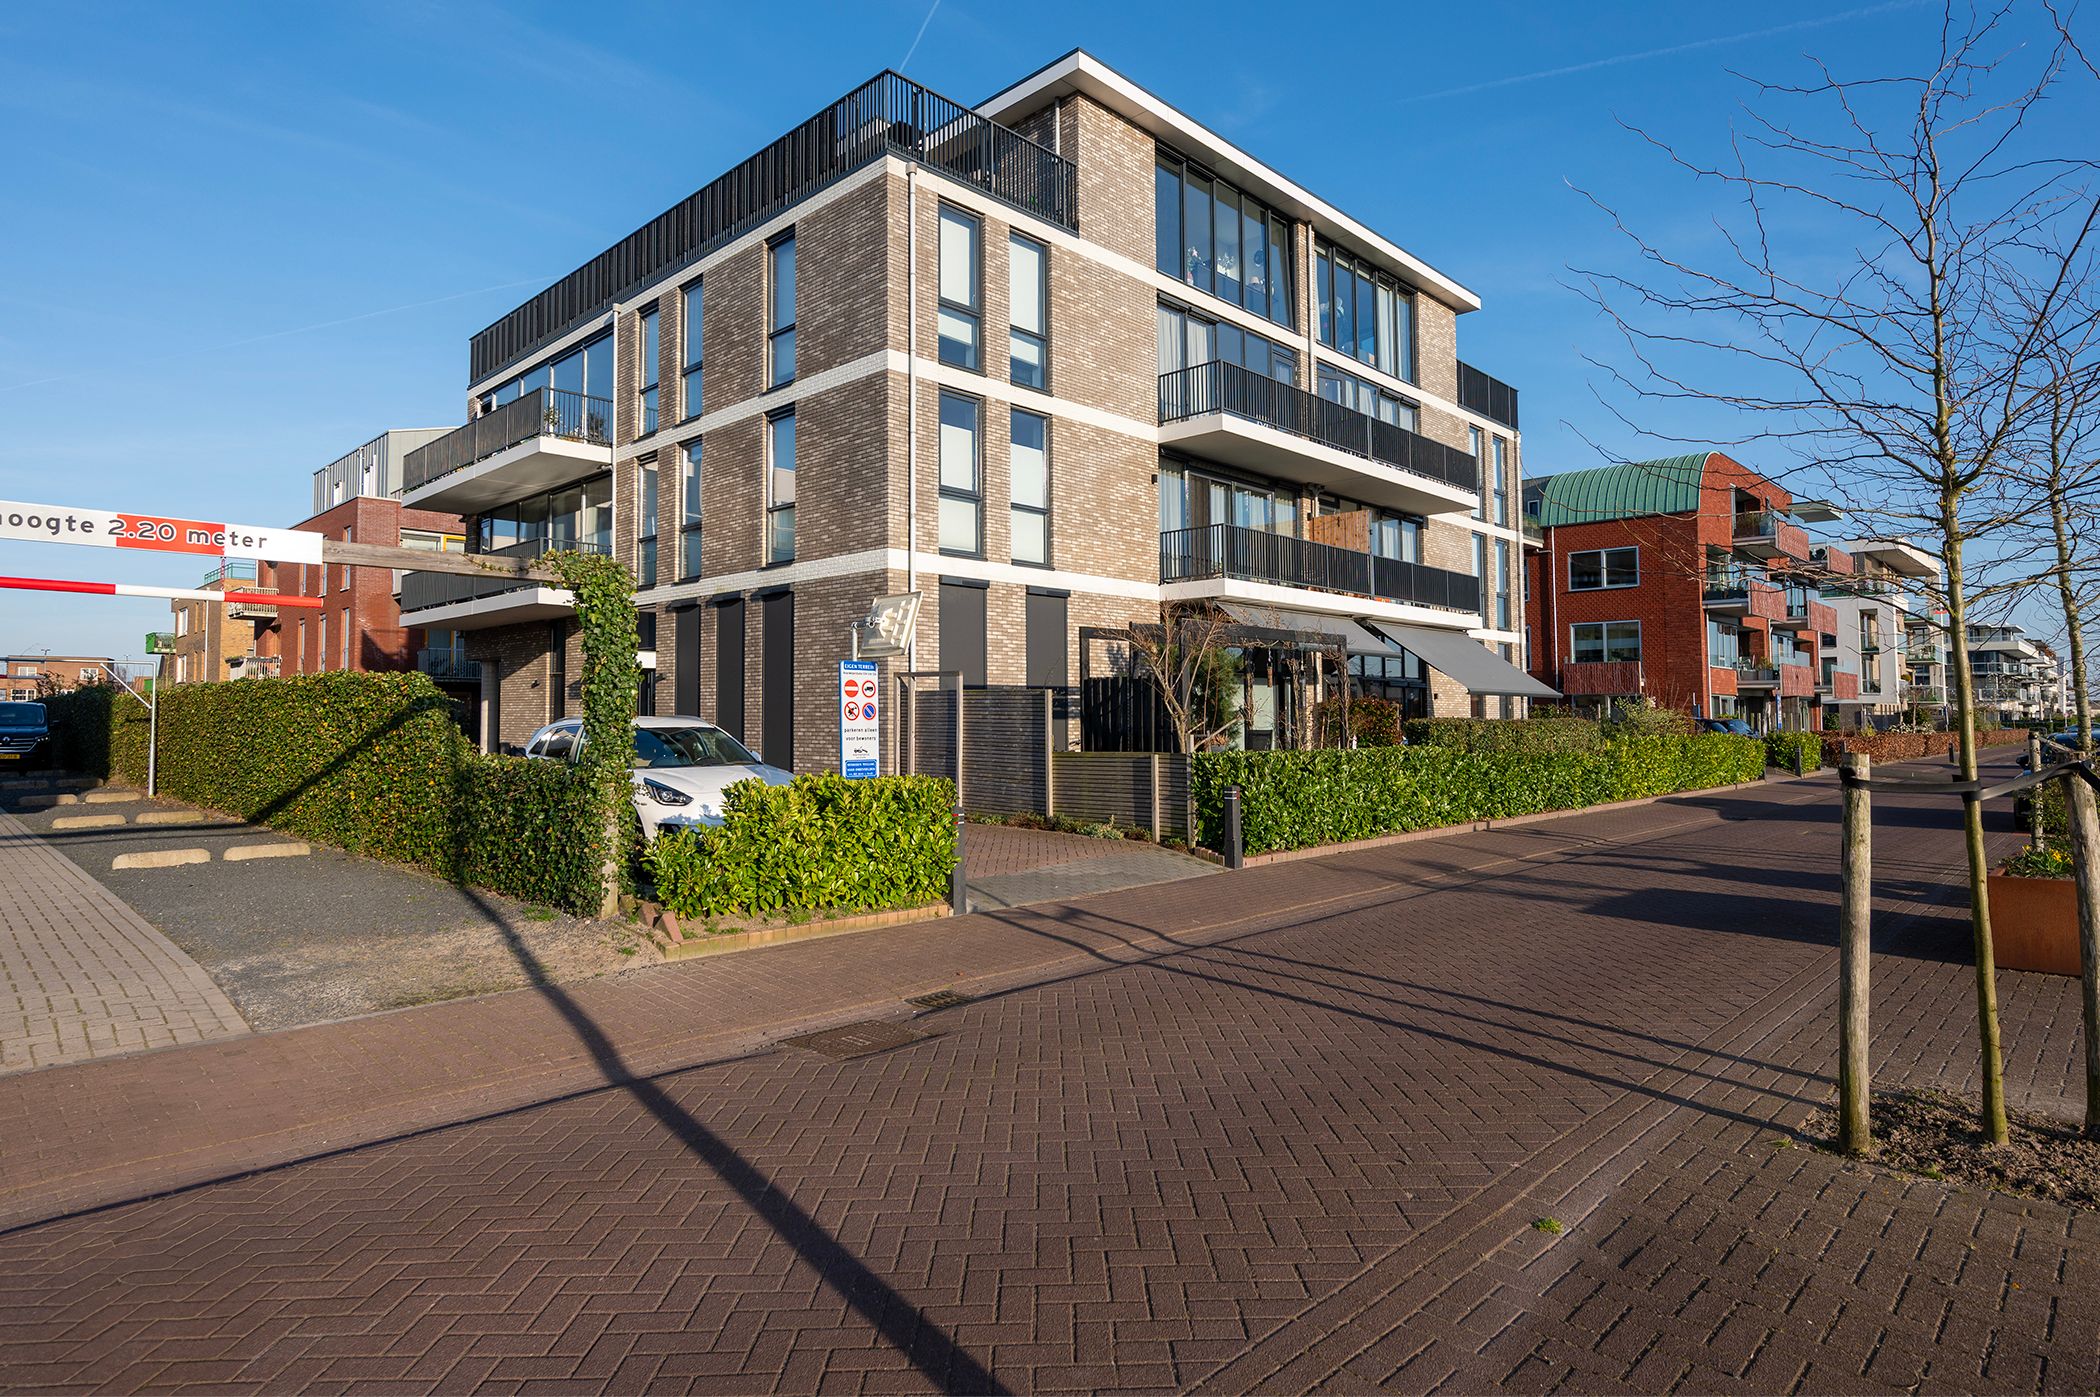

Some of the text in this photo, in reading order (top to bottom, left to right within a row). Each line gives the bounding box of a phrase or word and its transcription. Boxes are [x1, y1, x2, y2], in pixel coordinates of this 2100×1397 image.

[0, 513, 267, 549] oogte 2.20 meter
